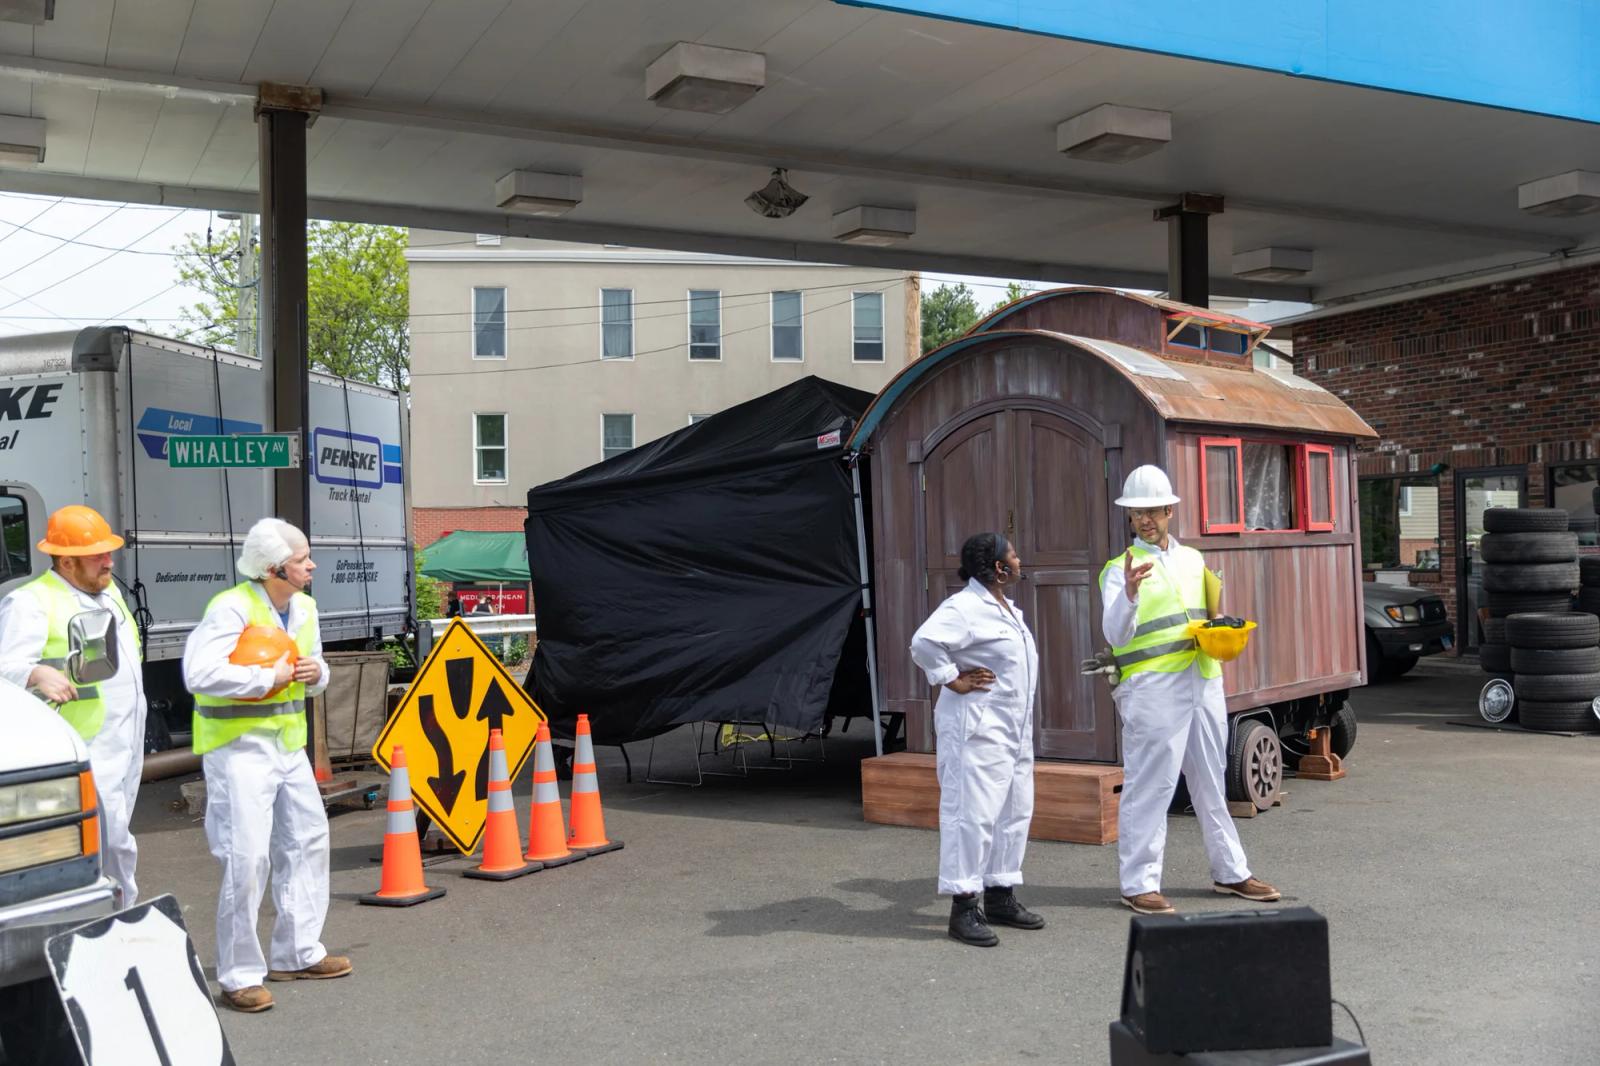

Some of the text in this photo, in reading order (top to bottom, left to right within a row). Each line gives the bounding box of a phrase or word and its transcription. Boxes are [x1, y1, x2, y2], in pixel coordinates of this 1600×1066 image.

[168, 415, 193, 432] Local
[175, 441, 268, 464] WHALLEY
[272, 441, 285, 453] AV
[320, 446, 377, 471] PENSKE
[328, 487, 372, 504] Truck Rental
[155, 571, 189, 583] Dedication
[189, 573, 197, 582] at
[197, 573, 213, 584] every
